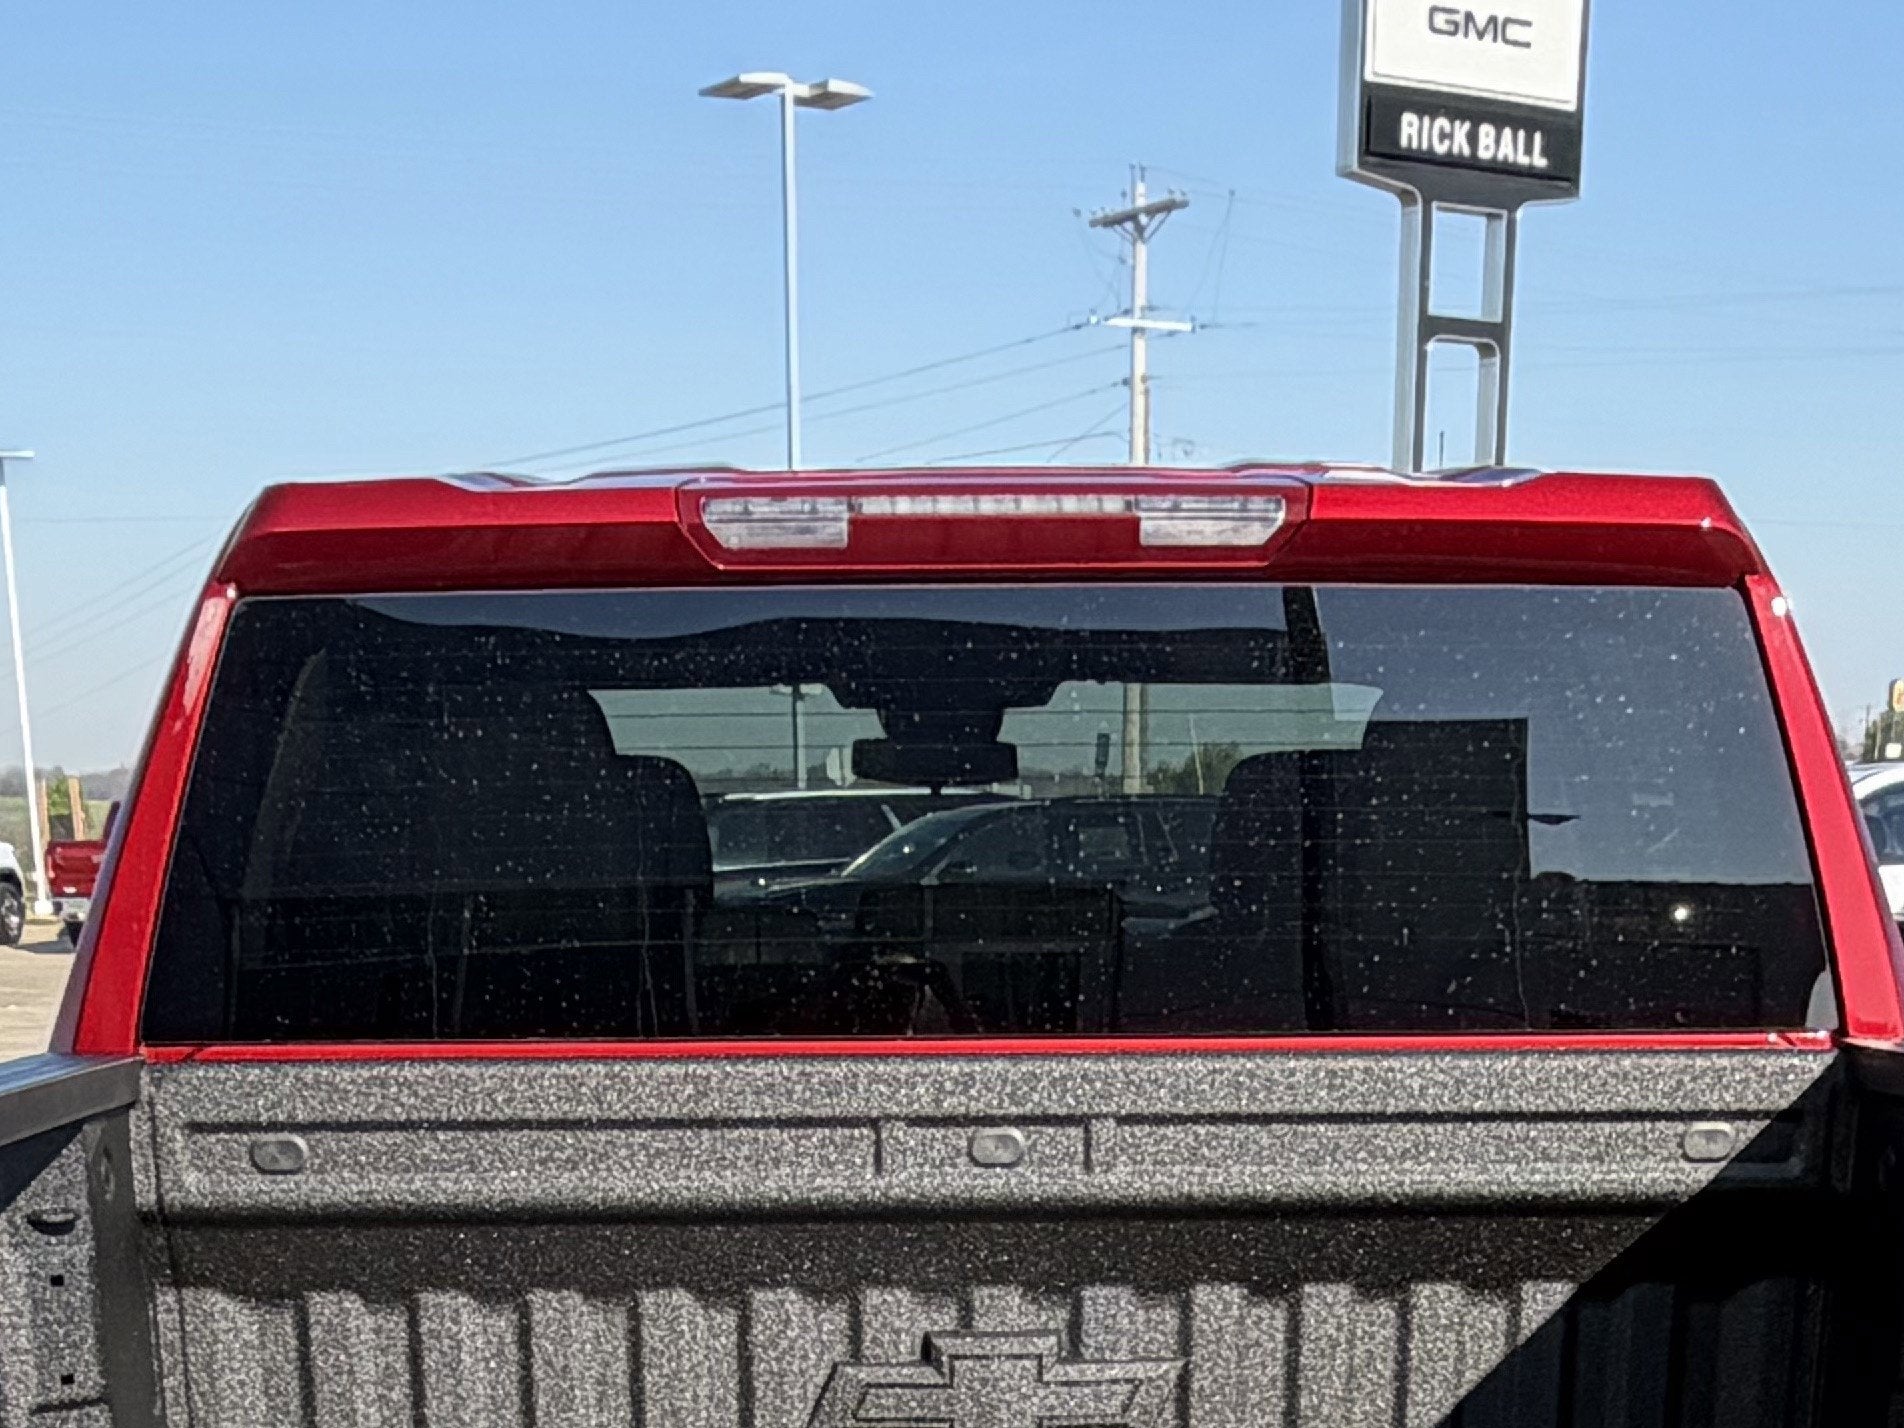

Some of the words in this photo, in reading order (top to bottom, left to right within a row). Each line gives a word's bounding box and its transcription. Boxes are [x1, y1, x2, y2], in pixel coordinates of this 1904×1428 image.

[1428, 4, 1532, 49] GMC
[1399, 110, 1472, 158] RICK
[1476, 122, 1549, 168] BALL
